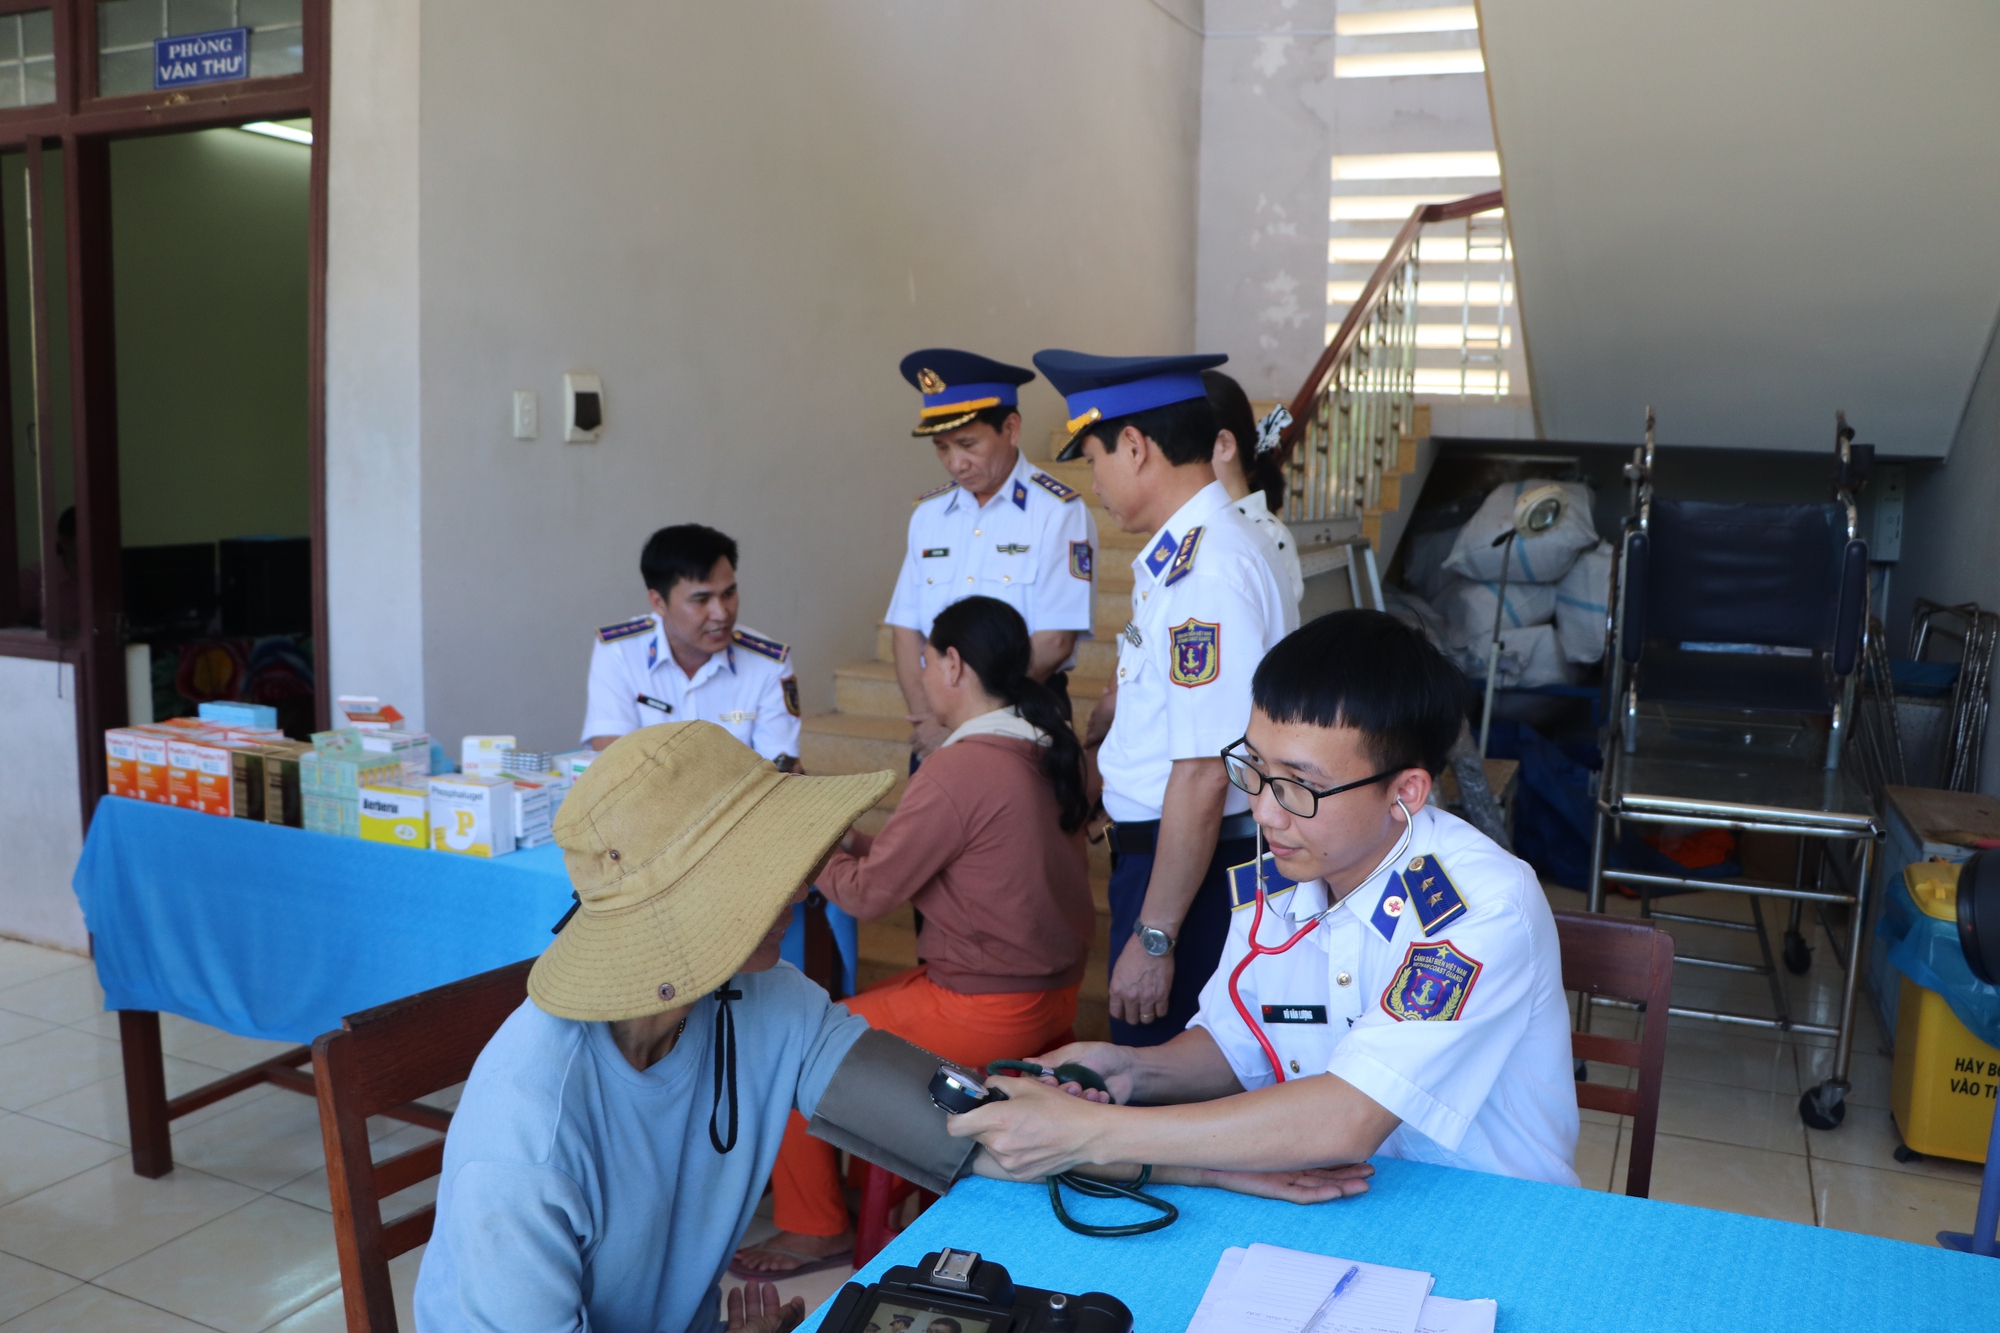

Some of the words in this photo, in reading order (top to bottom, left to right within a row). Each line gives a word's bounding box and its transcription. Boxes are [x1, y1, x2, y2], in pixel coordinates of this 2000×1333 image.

[168, 37, 233, 60] PHÒNG
[160, 61, 198, 81] VĂN
[202, 55, 242, 75] THƯ
[431, 785, 484, 802] Phosphalugel
[363, 798, 398, 814] Berberin
[455, 810, 475, 837] P
[1425, 956, 1435, 964] SÁT
[1455, 966, 1468, 977] NAM
[1429, 964, 1447, 975] COAST
[1445, 970, 1464, 983] GUARD
[1954, 1057, 1985, 1075] HÃY
[1987, 1062, 2000, 1077] B
[1951, 1077, 1980, 1096] VÀO
